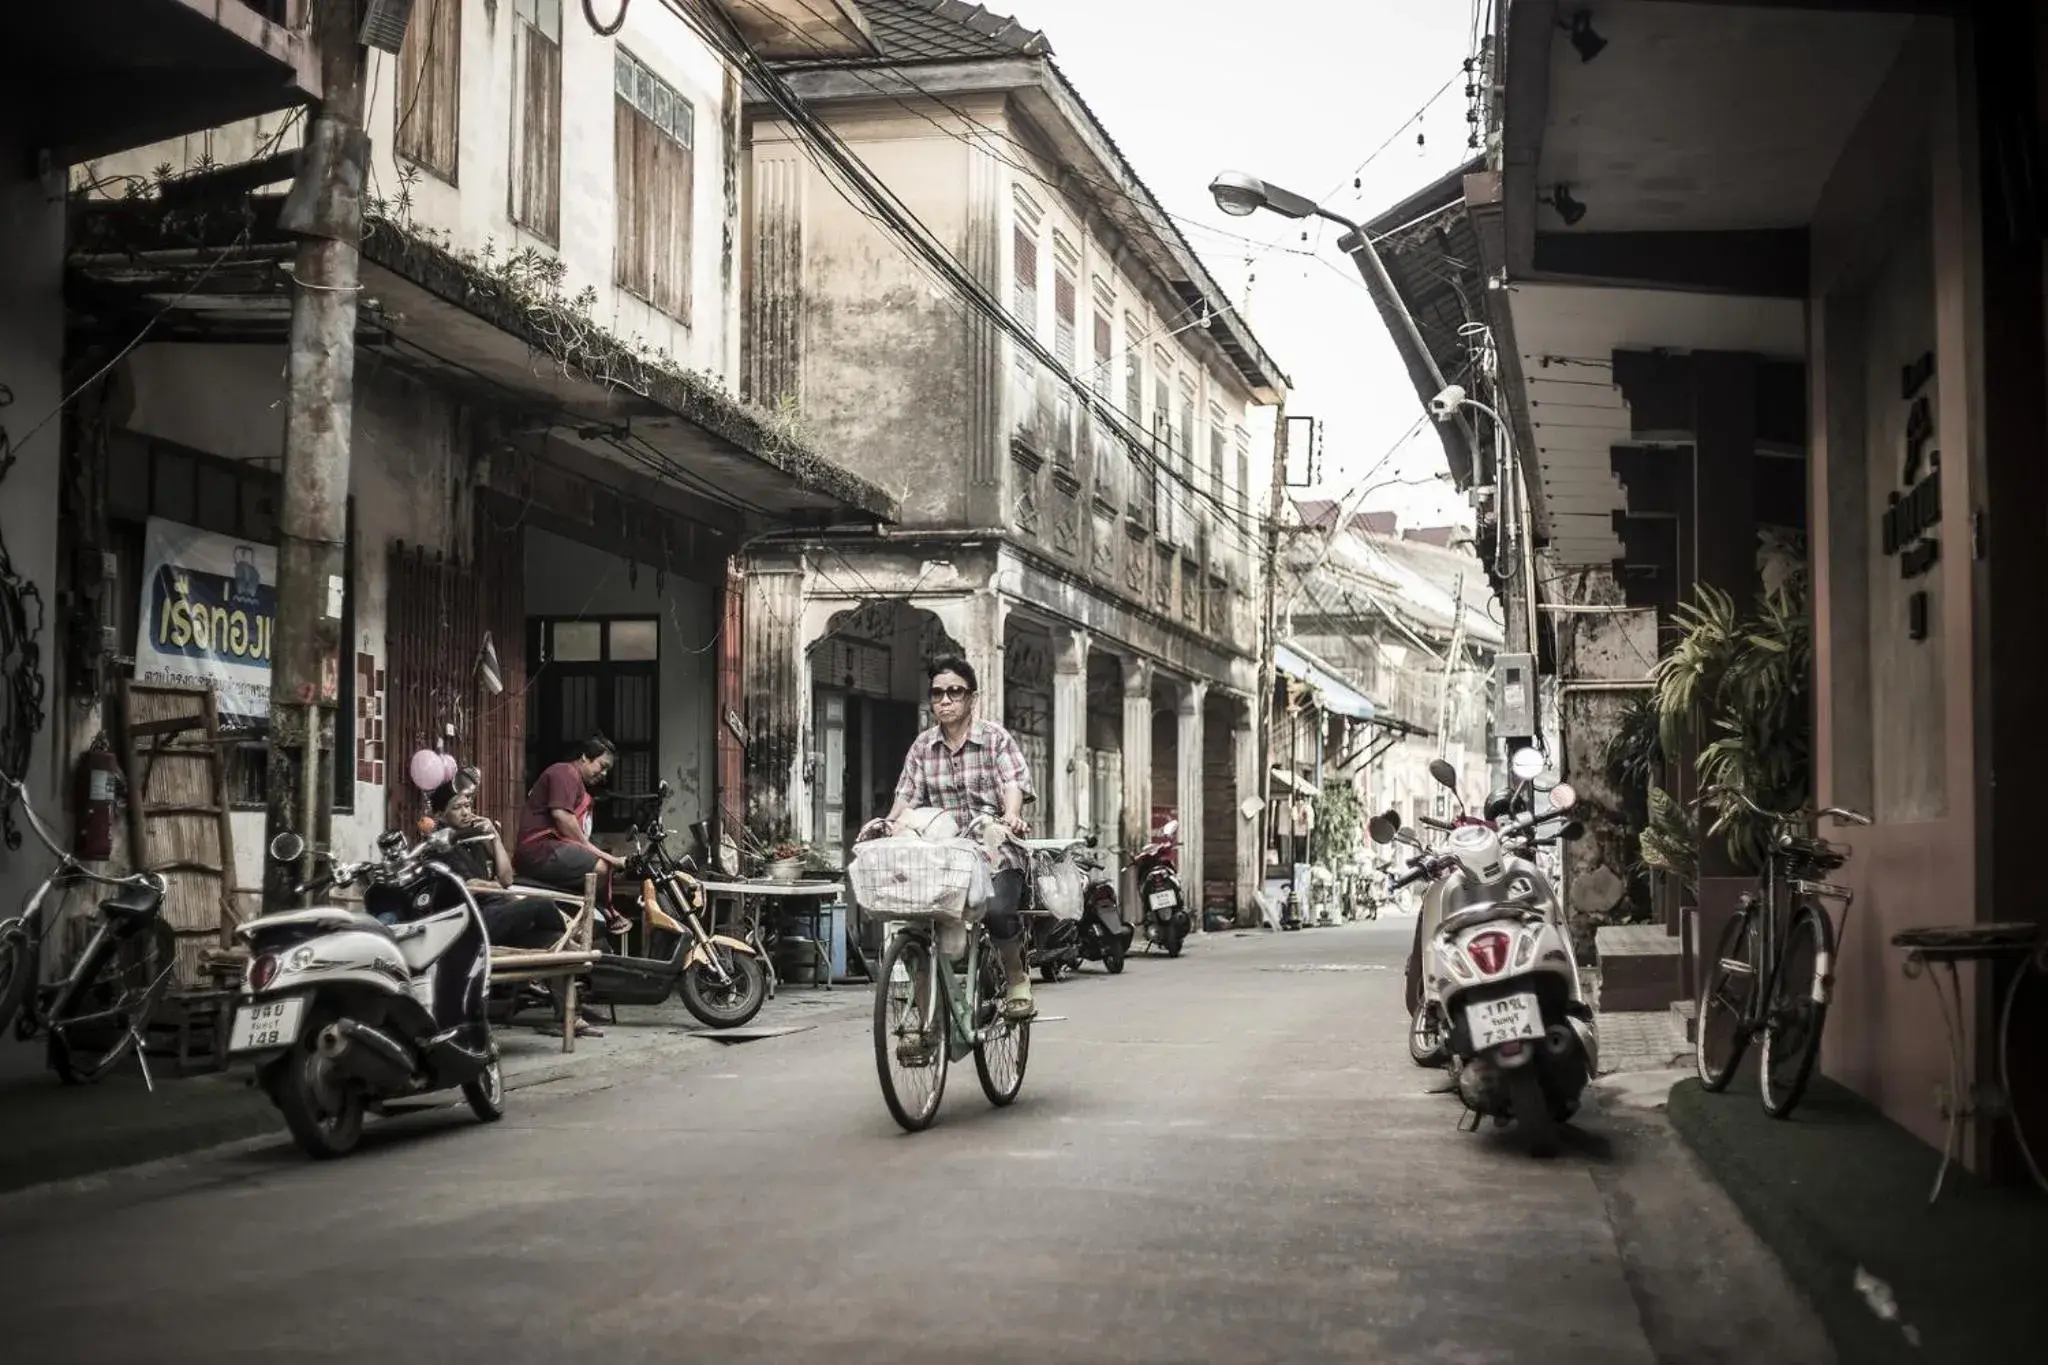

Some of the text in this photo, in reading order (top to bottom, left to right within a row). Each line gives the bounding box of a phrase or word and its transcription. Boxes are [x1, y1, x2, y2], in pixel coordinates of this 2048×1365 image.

[160, 573, 276, 660] เรือท่องเ
[248, 1030, 279, 1046] 148
[1483, 1023, 1532, 1043] 7314
